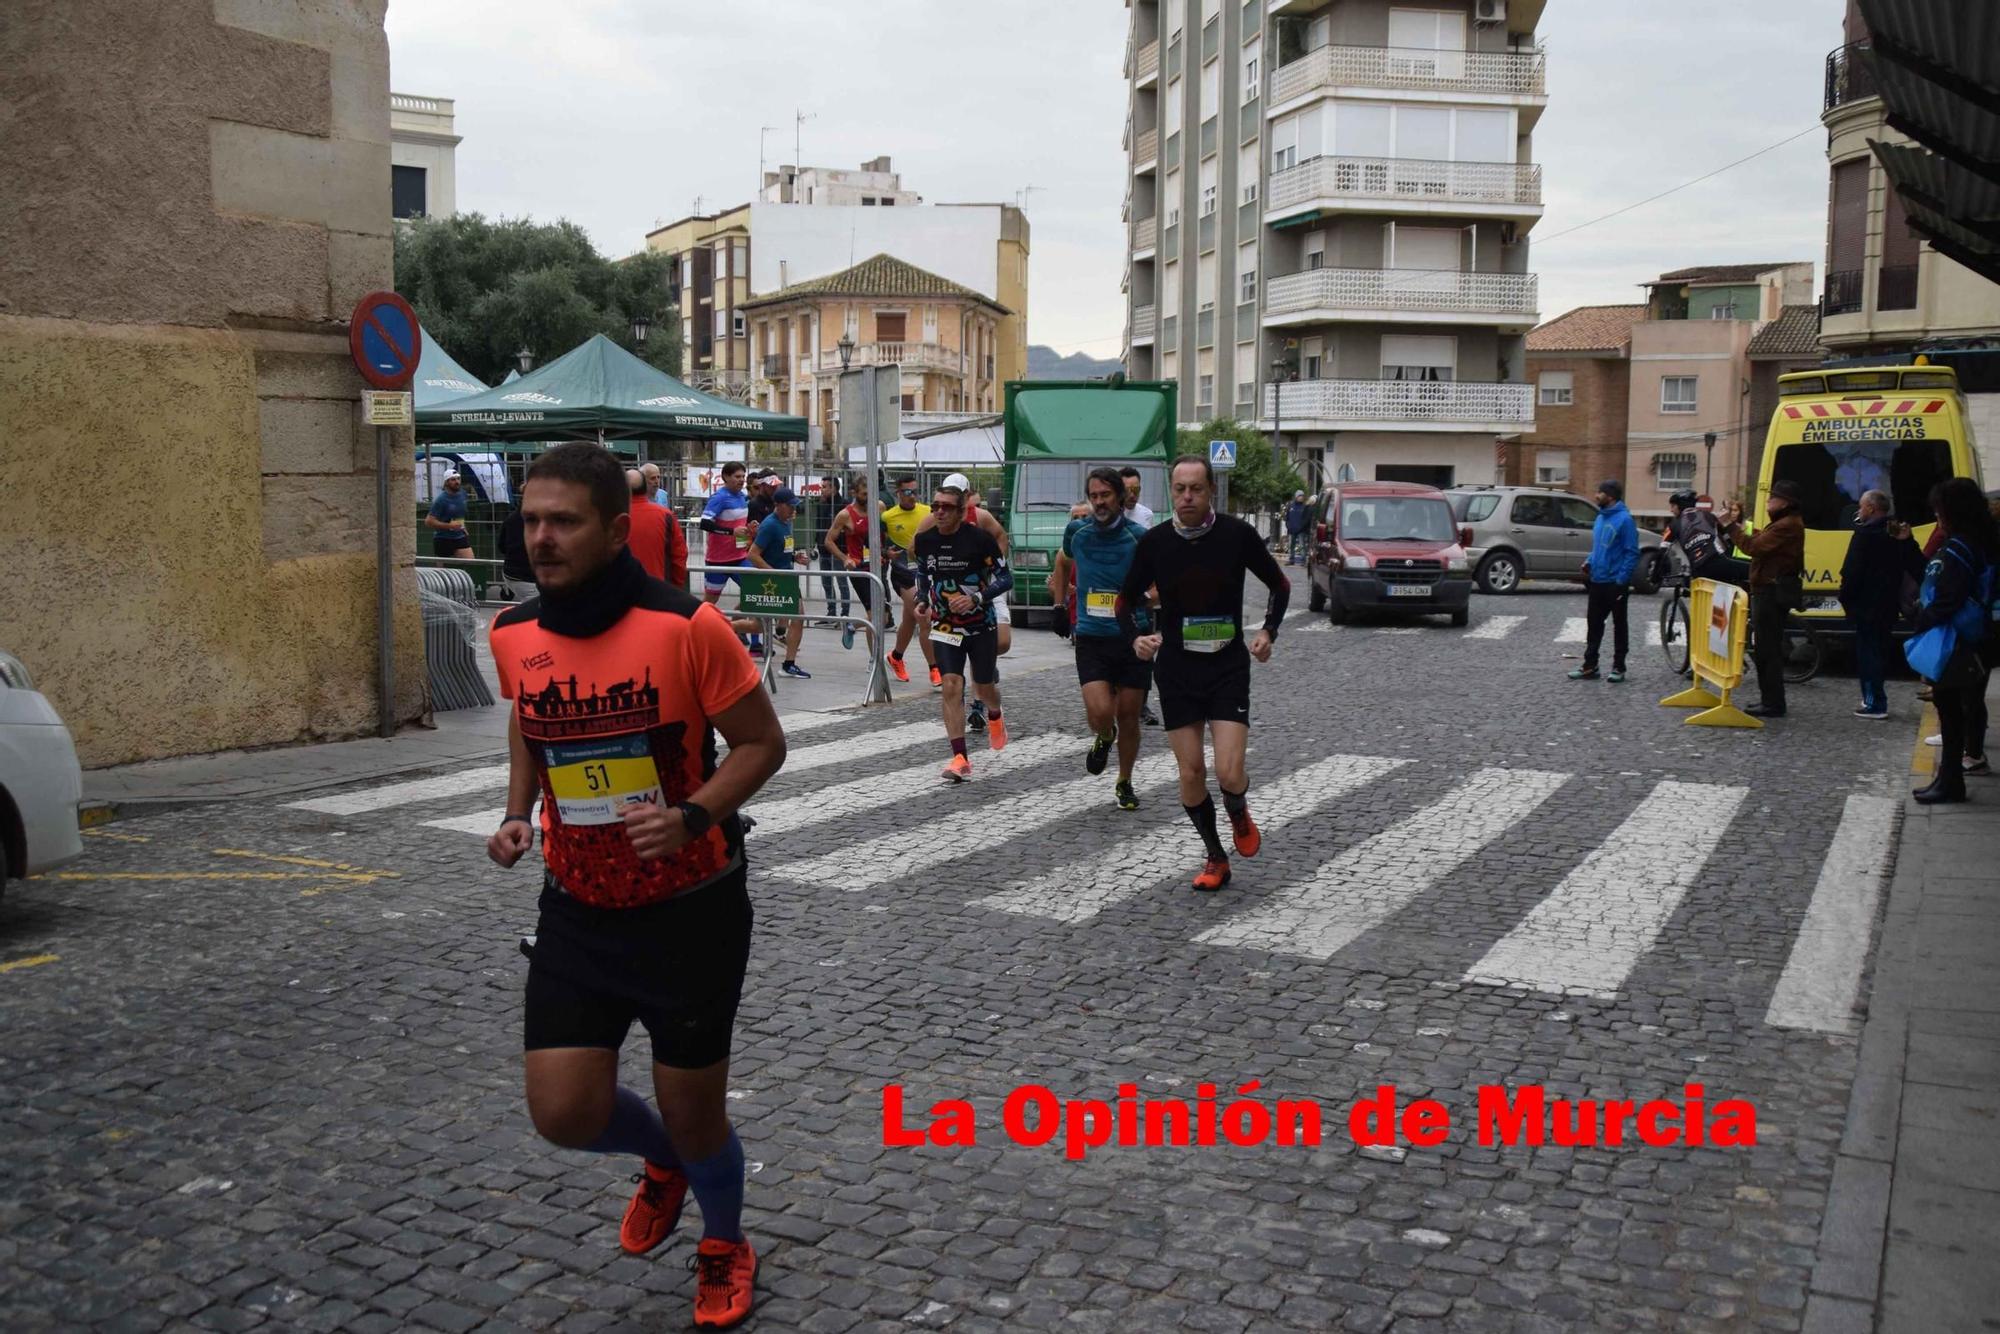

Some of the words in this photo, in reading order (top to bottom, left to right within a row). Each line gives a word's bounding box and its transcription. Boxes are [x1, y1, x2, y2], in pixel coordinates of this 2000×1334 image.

[451, 412, 496, 423] ESTRELLA
[503, 411, 545, 422] LEVANTE
[674, 415, 719, 427] ESTRELLA
[726, 419, 764, 430] LEVANTE
[1805, 417, 1924, 431] AMBULACIAS
[1802, 428, 1926, 442] EMERGENCIAS
[745, 594, 794, 605] ESTRELLA
[1100, 594, 1114, 605] 301
[1200, 625, 1218, 638] 731
[584, 764, 610, 790] 51
